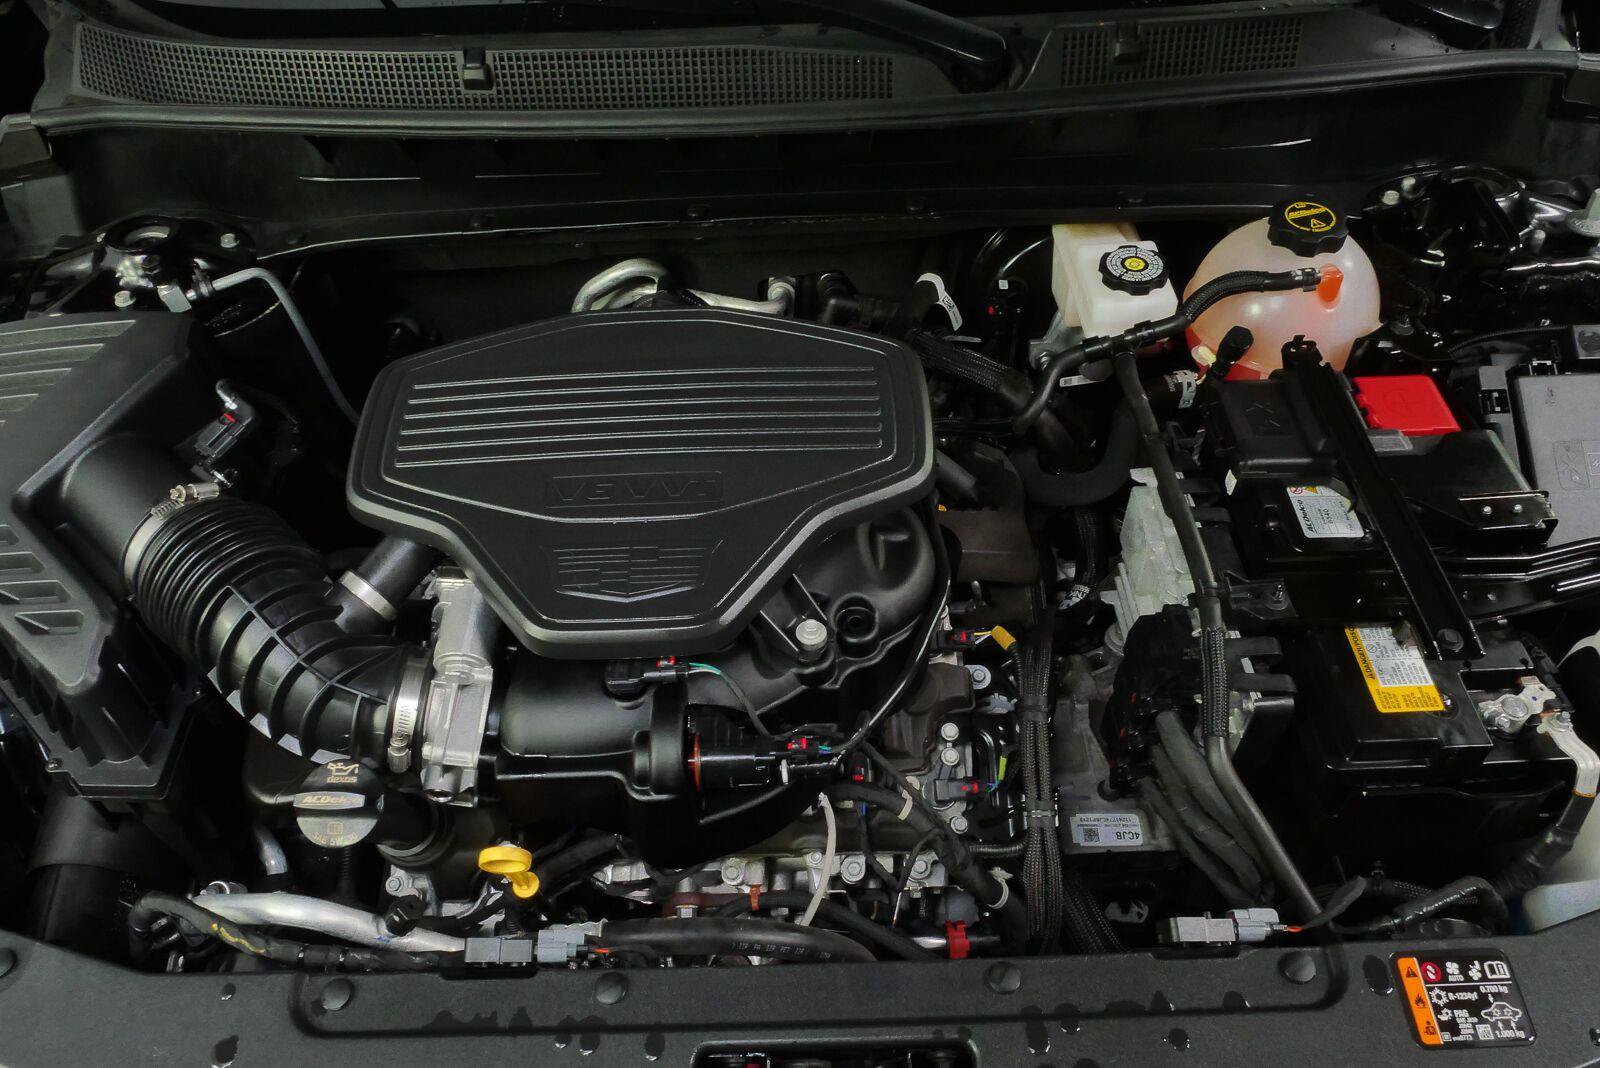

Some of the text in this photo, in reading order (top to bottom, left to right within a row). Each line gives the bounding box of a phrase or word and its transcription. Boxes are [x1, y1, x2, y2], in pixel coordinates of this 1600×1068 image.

[1297, 499, 1315, 533] ACDelco
[1116, 831, 1141, 841] 4CJB
[1448, 974, 1465, 982] AUTO
[1479, 985, 1509, 994] 0.700 kg
[1448, 992, 1479, 1002] R-1234yf
[1453, 1009, 1470, 1018] PAG
[1495, 1029, 1525, 1039] 1.000 kg
